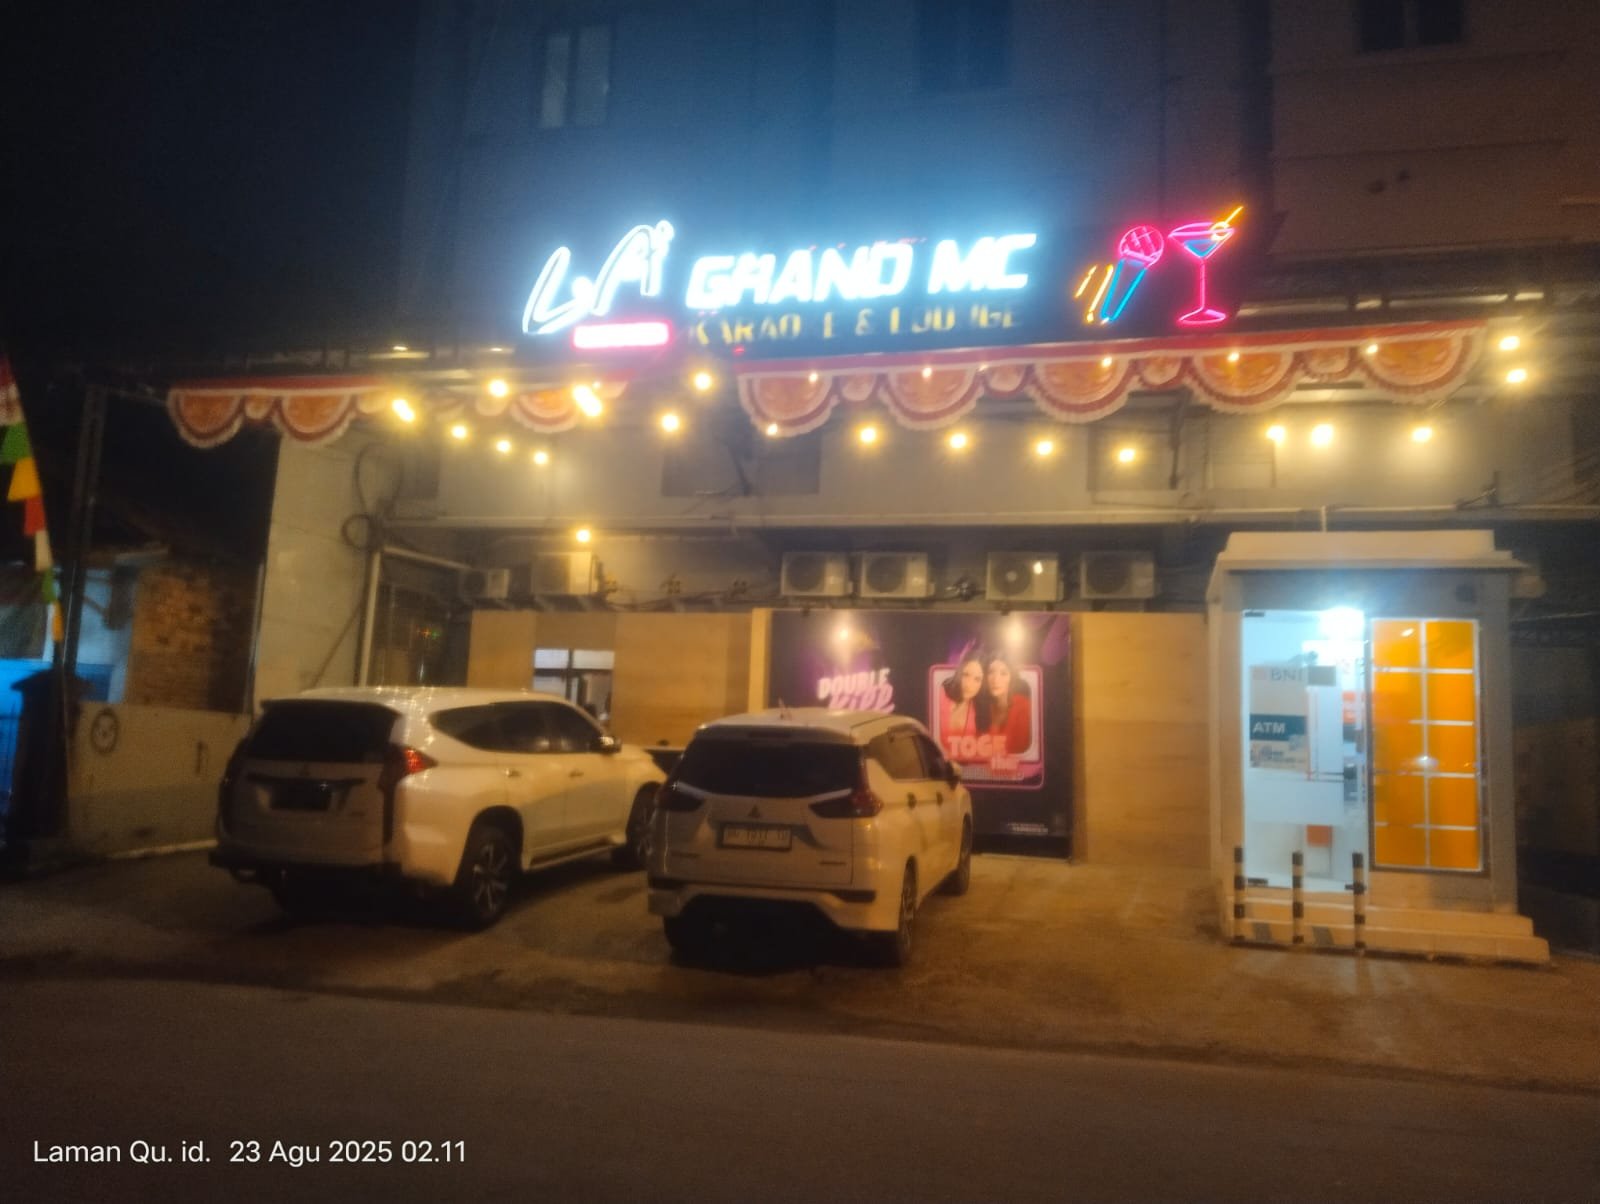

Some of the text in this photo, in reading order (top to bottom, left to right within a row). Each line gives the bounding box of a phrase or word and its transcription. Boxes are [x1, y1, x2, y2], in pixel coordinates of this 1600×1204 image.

[685, 233, 1036, 309] GRAND MC
[816, 666, 891, 701] DOUBLE
[1252, 721, 1286, 735] ATM
